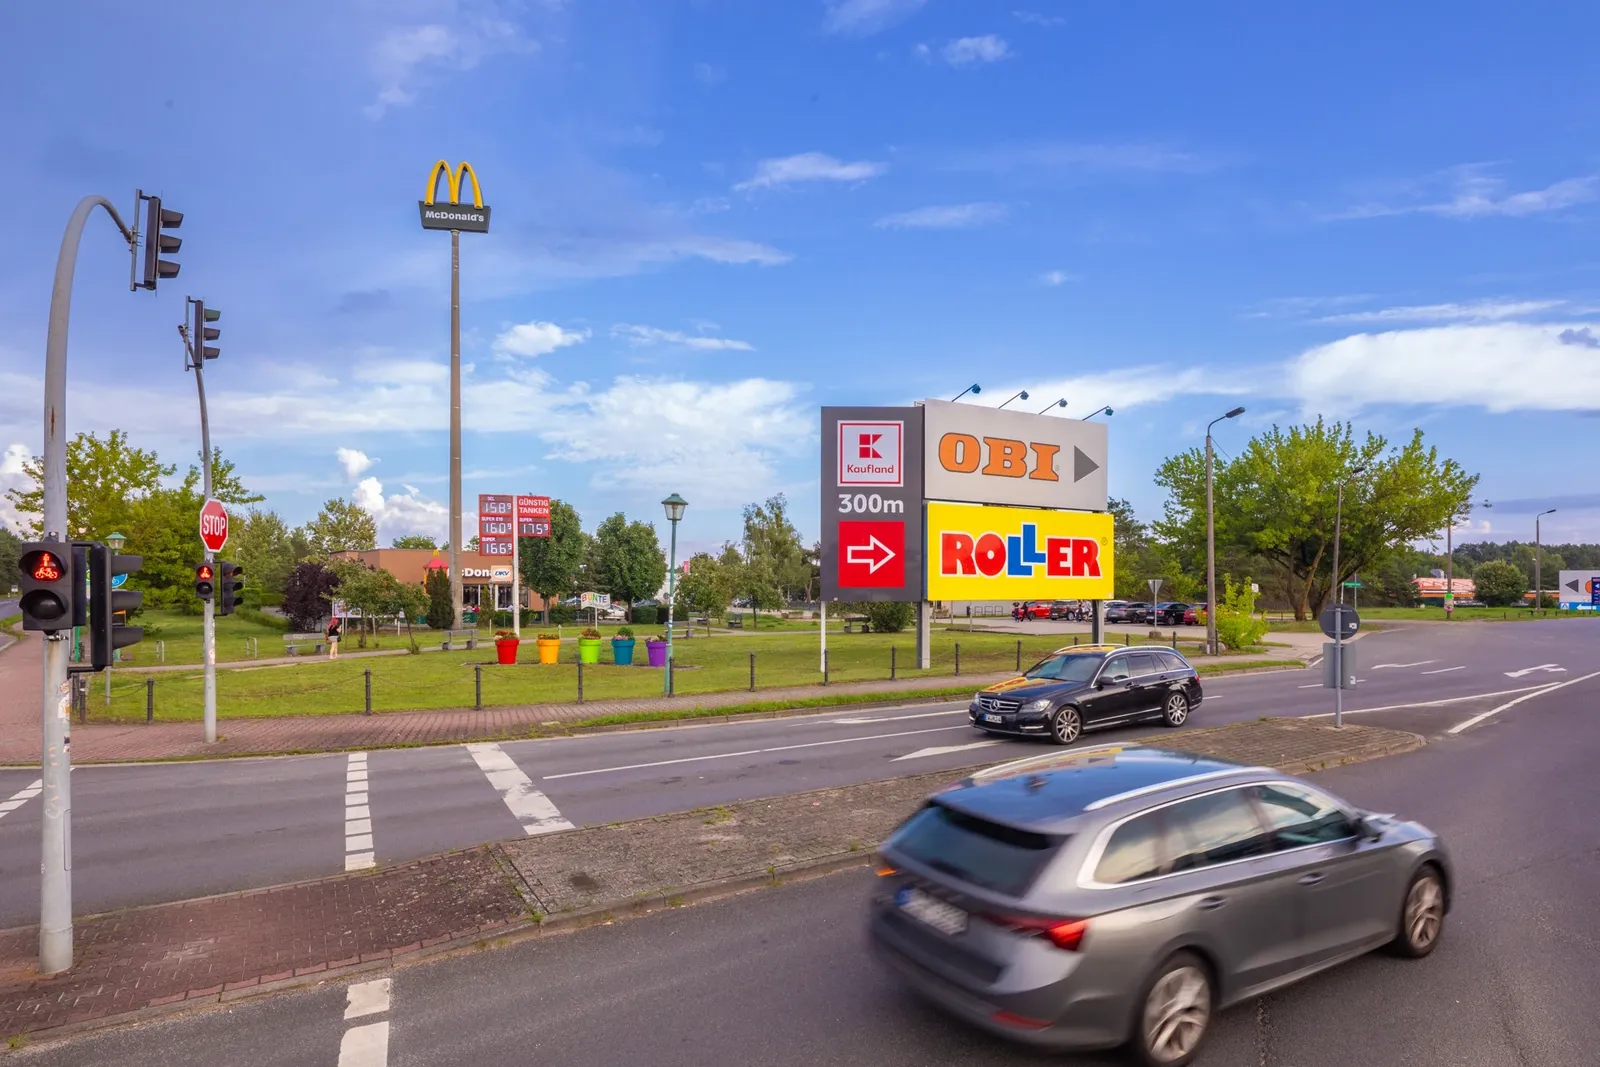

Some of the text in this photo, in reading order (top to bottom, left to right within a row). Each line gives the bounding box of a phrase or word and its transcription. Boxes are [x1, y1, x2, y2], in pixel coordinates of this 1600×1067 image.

[425, 210, 485, 222] McDonald's
[938, 432, 1061, 482] OBI
[846, 464, 895, 474] Kaufland
[518, 498, 549, 507] GÜNSTIG
[838, 493, 904, 513] 300m
[203, 514, 226, 537] STOP
[939, 522, 1102, 578] ROLLER
[581, 593, 608, 604] BUNTE
